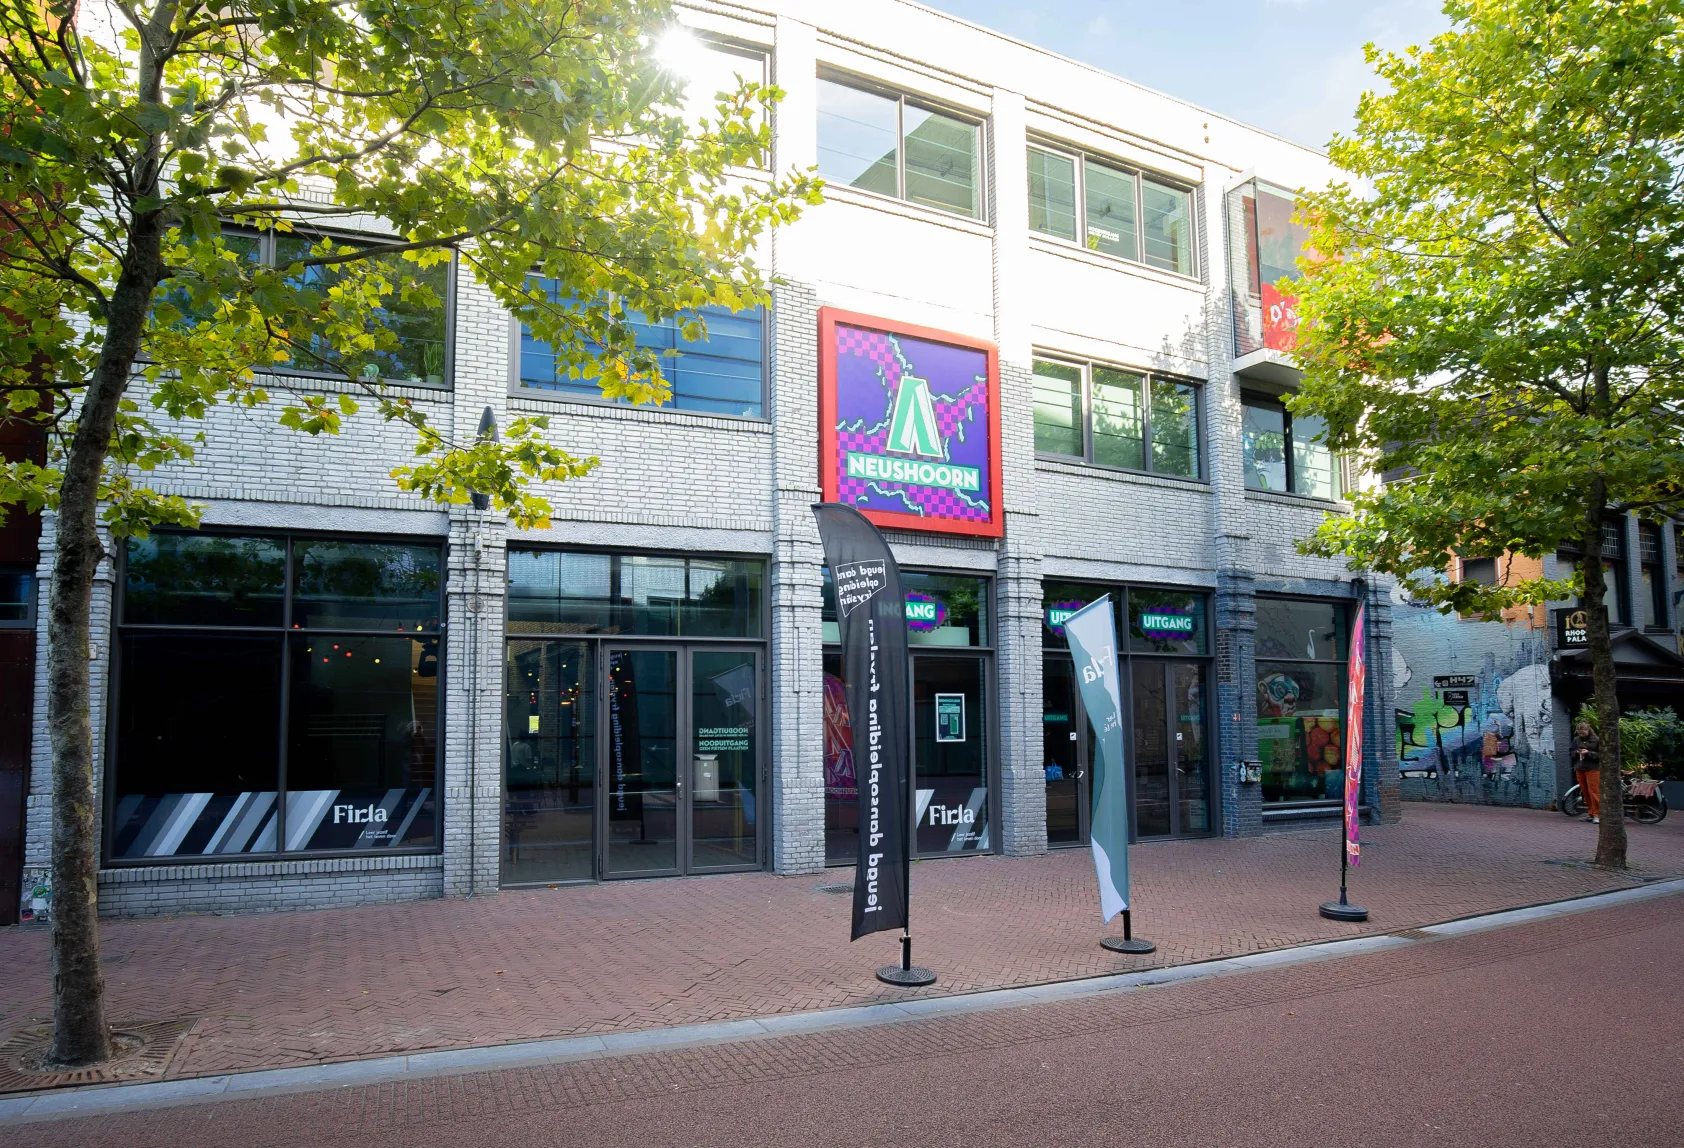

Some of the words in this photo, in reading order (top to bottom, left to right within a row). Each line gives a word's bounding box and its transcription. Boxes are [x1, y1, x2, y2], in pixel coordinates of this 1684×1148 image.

[849, 455, 978, 489] NEUSHOORN
[1143, 615, 1192, 631] UITGANG
[1565, 629, 1587, 637] RHOD
[1449, 676, 1474, 684] H47
[333, 803, 388, 824] Firda
[929, 804, 975, 826] Firda
